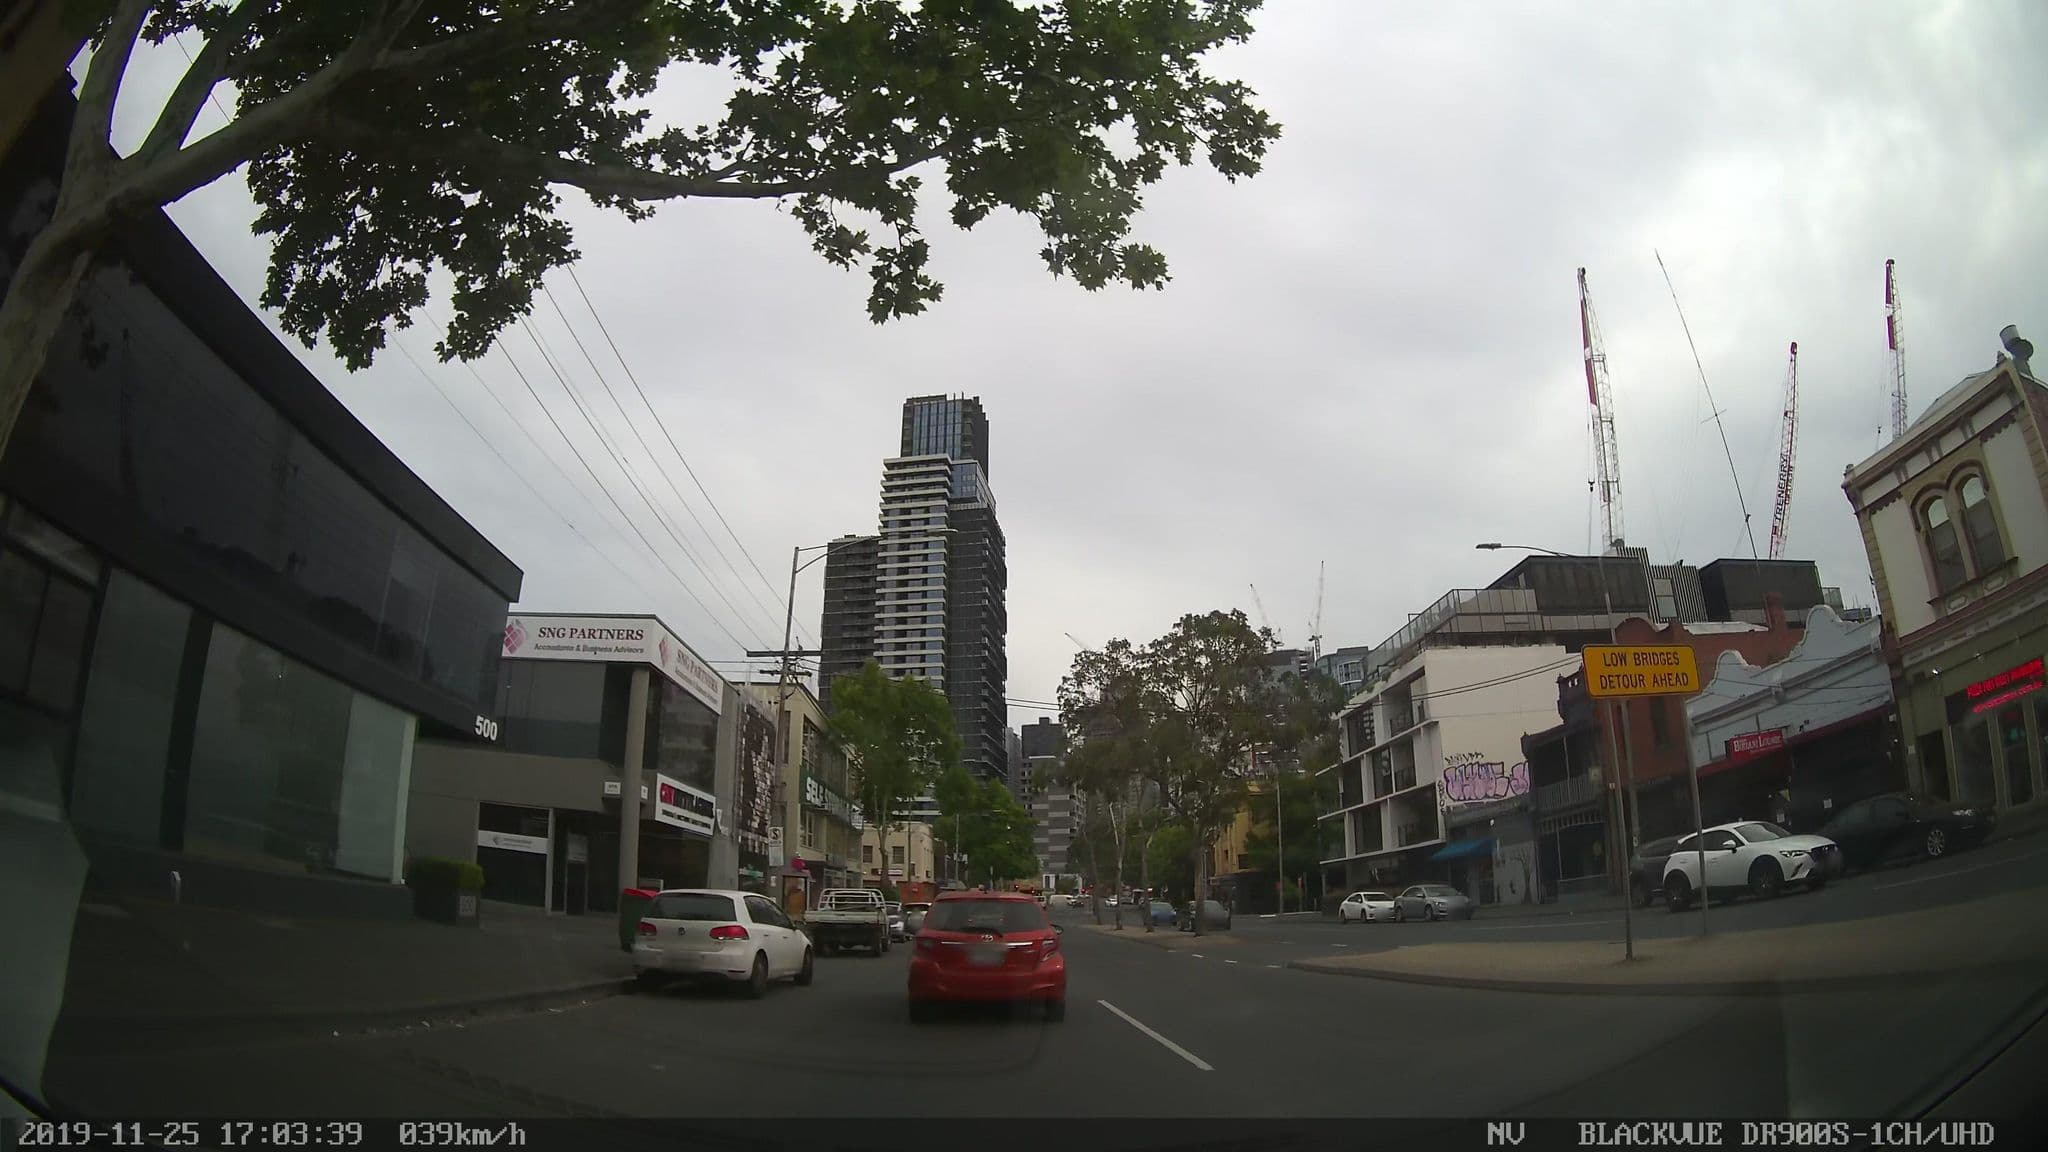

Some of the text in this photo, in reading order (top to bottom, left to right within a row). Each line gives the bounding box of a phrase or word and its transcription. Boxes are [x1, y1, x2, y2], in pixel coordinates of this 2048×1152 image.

[1774, 454, 1788, 522] TRENERRY
[538, 627, 644, 641] SNG PARTNERS
[1602, 651, 1680, 667] LOW BRIDGES
[1600, 672, 1689, 690] DETOUR AHEAD
[475, 715, 498, 741] 500
